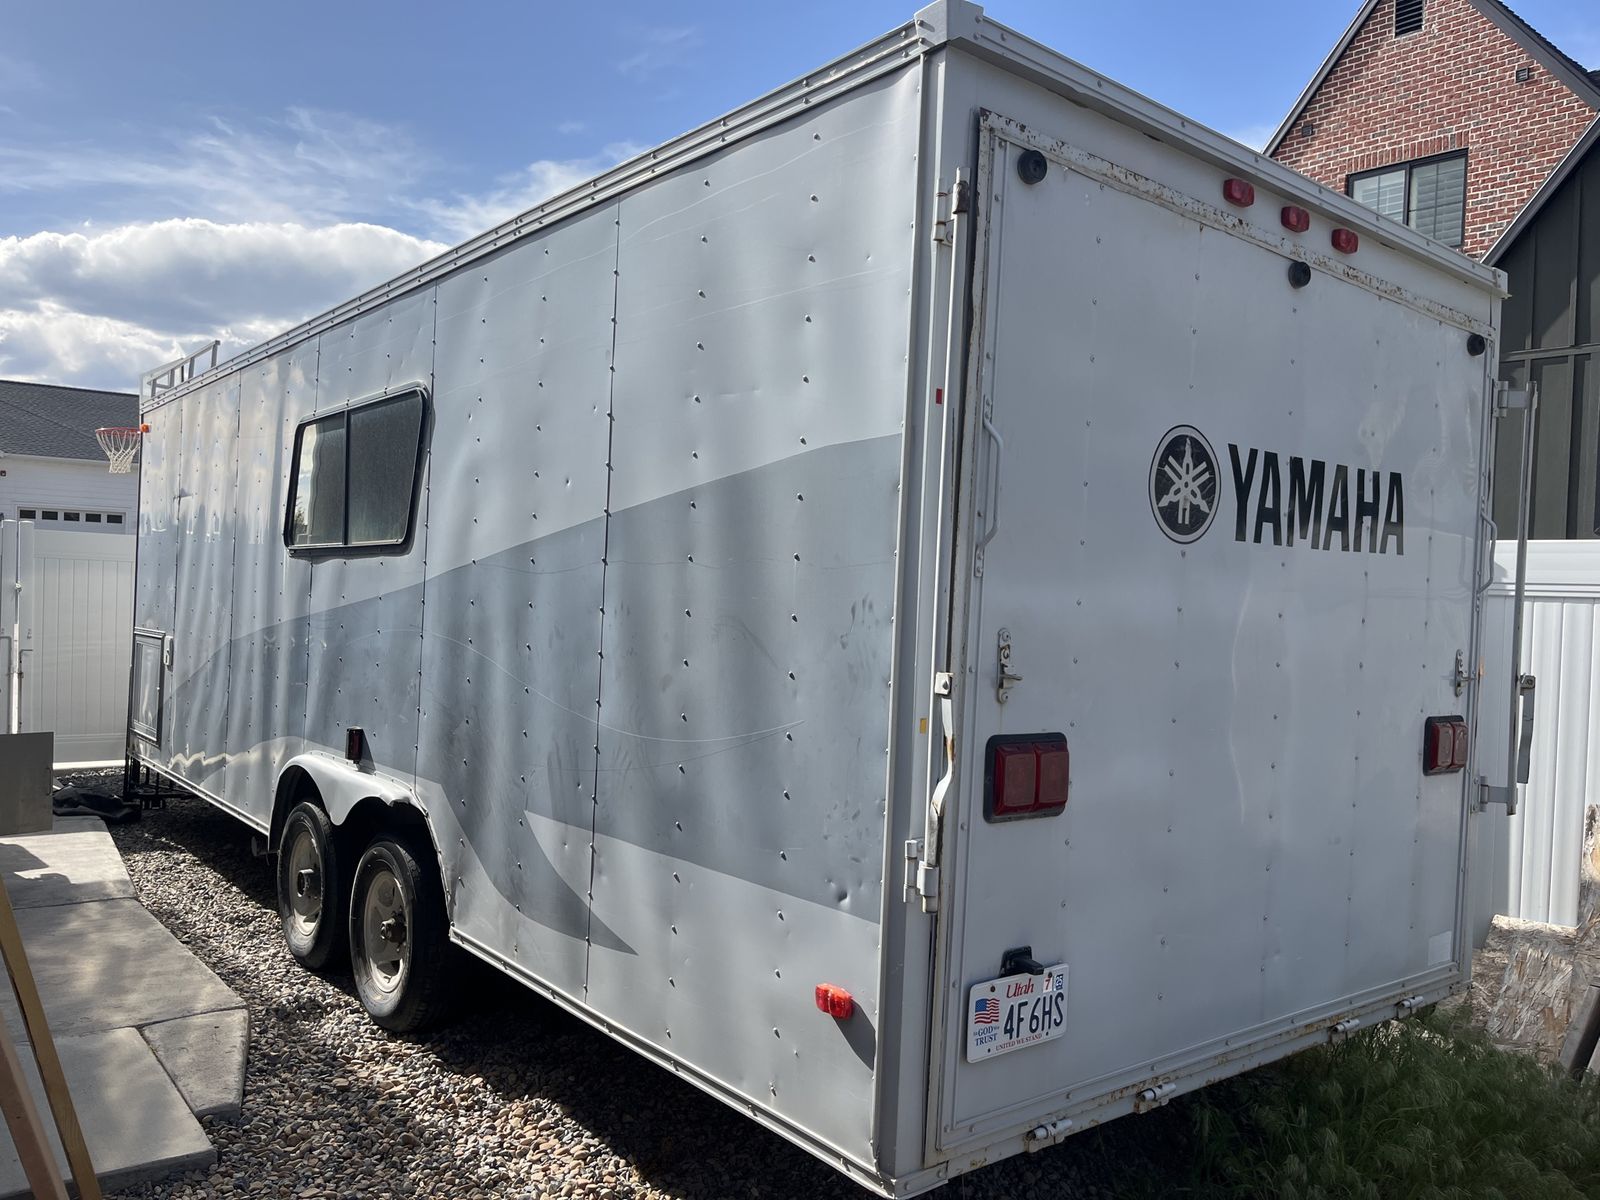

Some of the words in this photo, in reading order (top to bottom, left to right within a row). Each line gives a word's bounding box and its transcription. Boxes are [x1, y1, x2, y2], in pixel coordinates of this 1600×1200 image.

[1228, 443, 1404, 555] YAMAHA
[1006, 978, 1034, 998] Utah
[1045, 979, 1051, 990] 7
[1004, 992, 1064, 1040] 4F6HS
[976, 1033, 997, 1046] TRUST
[978, 1026, 993, 1037] GOD
[996, 1040, 1015, 1051] UNITED
[1025, 1033, 1043, 1042] STAND
